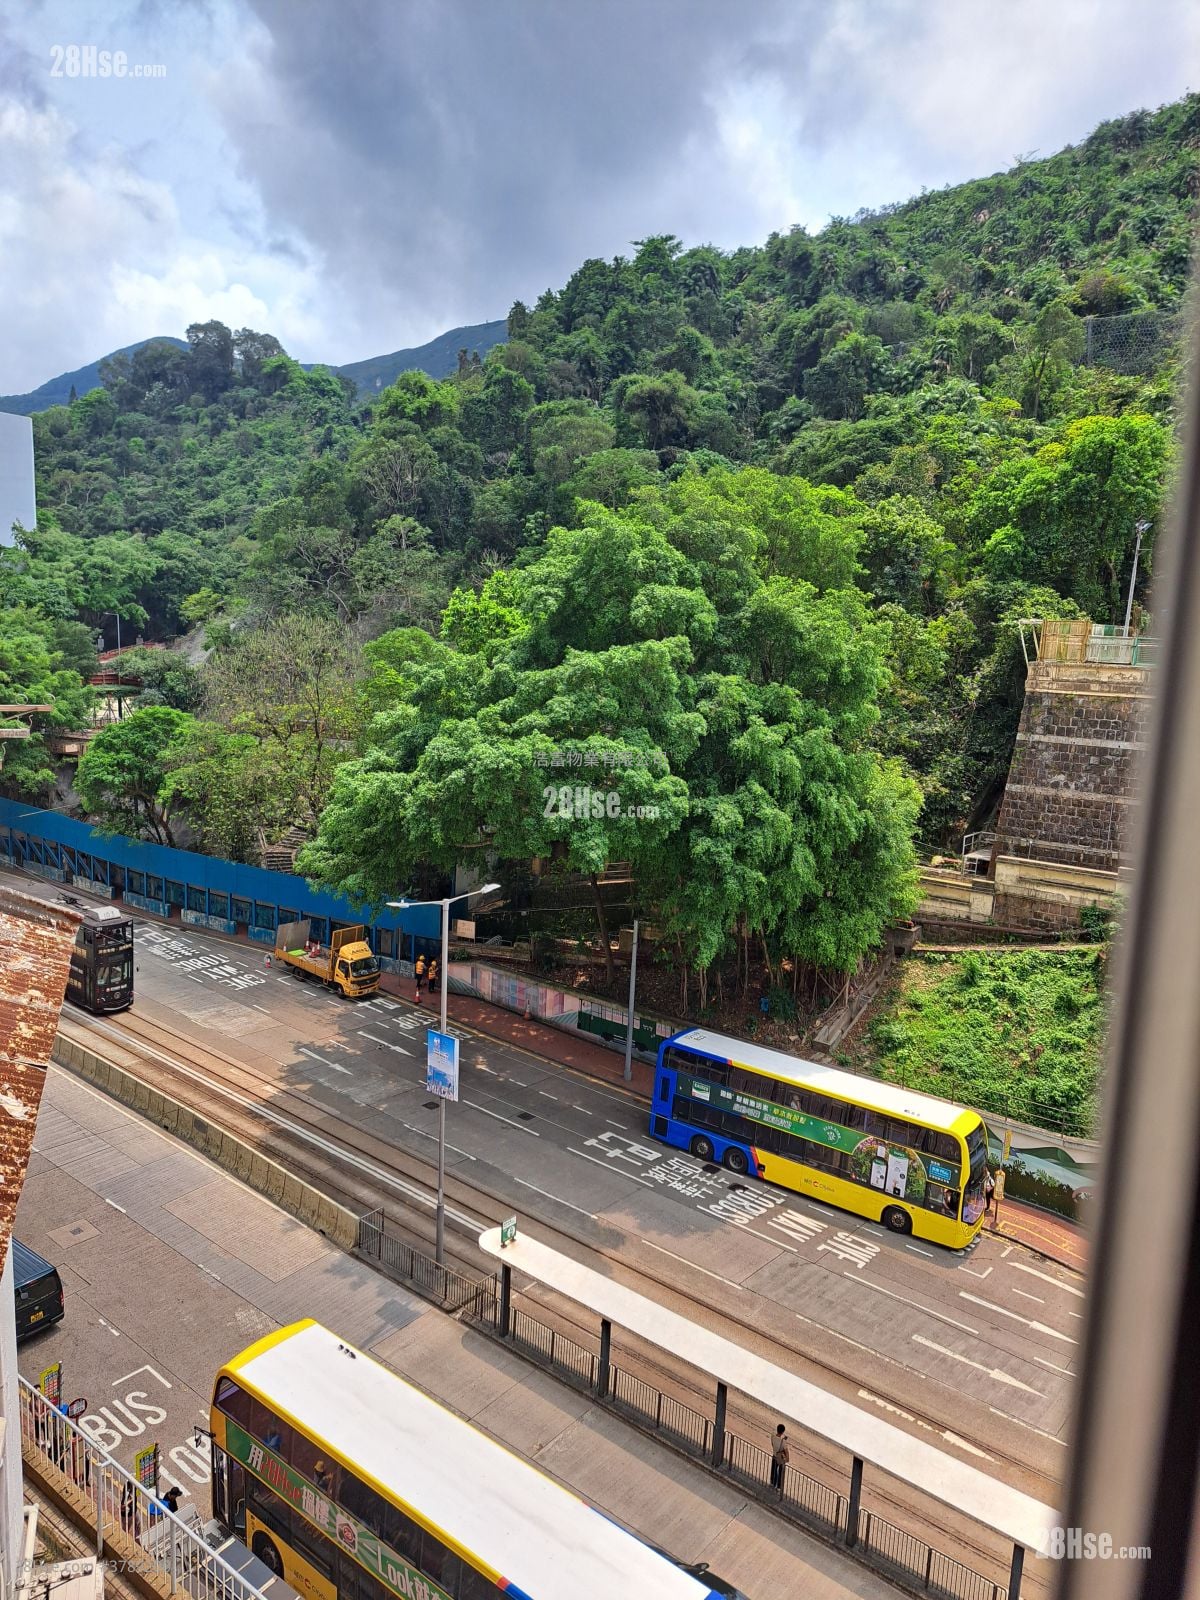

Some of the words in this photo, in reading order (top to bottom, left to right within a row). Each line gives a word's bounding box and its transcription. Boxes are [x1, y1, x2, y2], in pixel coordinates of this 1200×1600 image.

[200, 964, 239, 979] WAY
[219, 974, 266, 991] GIVE
[391, 1011, 438, 1030] STOP
[583, 1131, 663, 1167] 巴士
[767, 1209, 829, 1243] WAY
[817, 1231, 881, 1269] GIVE
[79, 1391, 168, 1453] BUS
[149, 1434, 212, 1499] TOP
